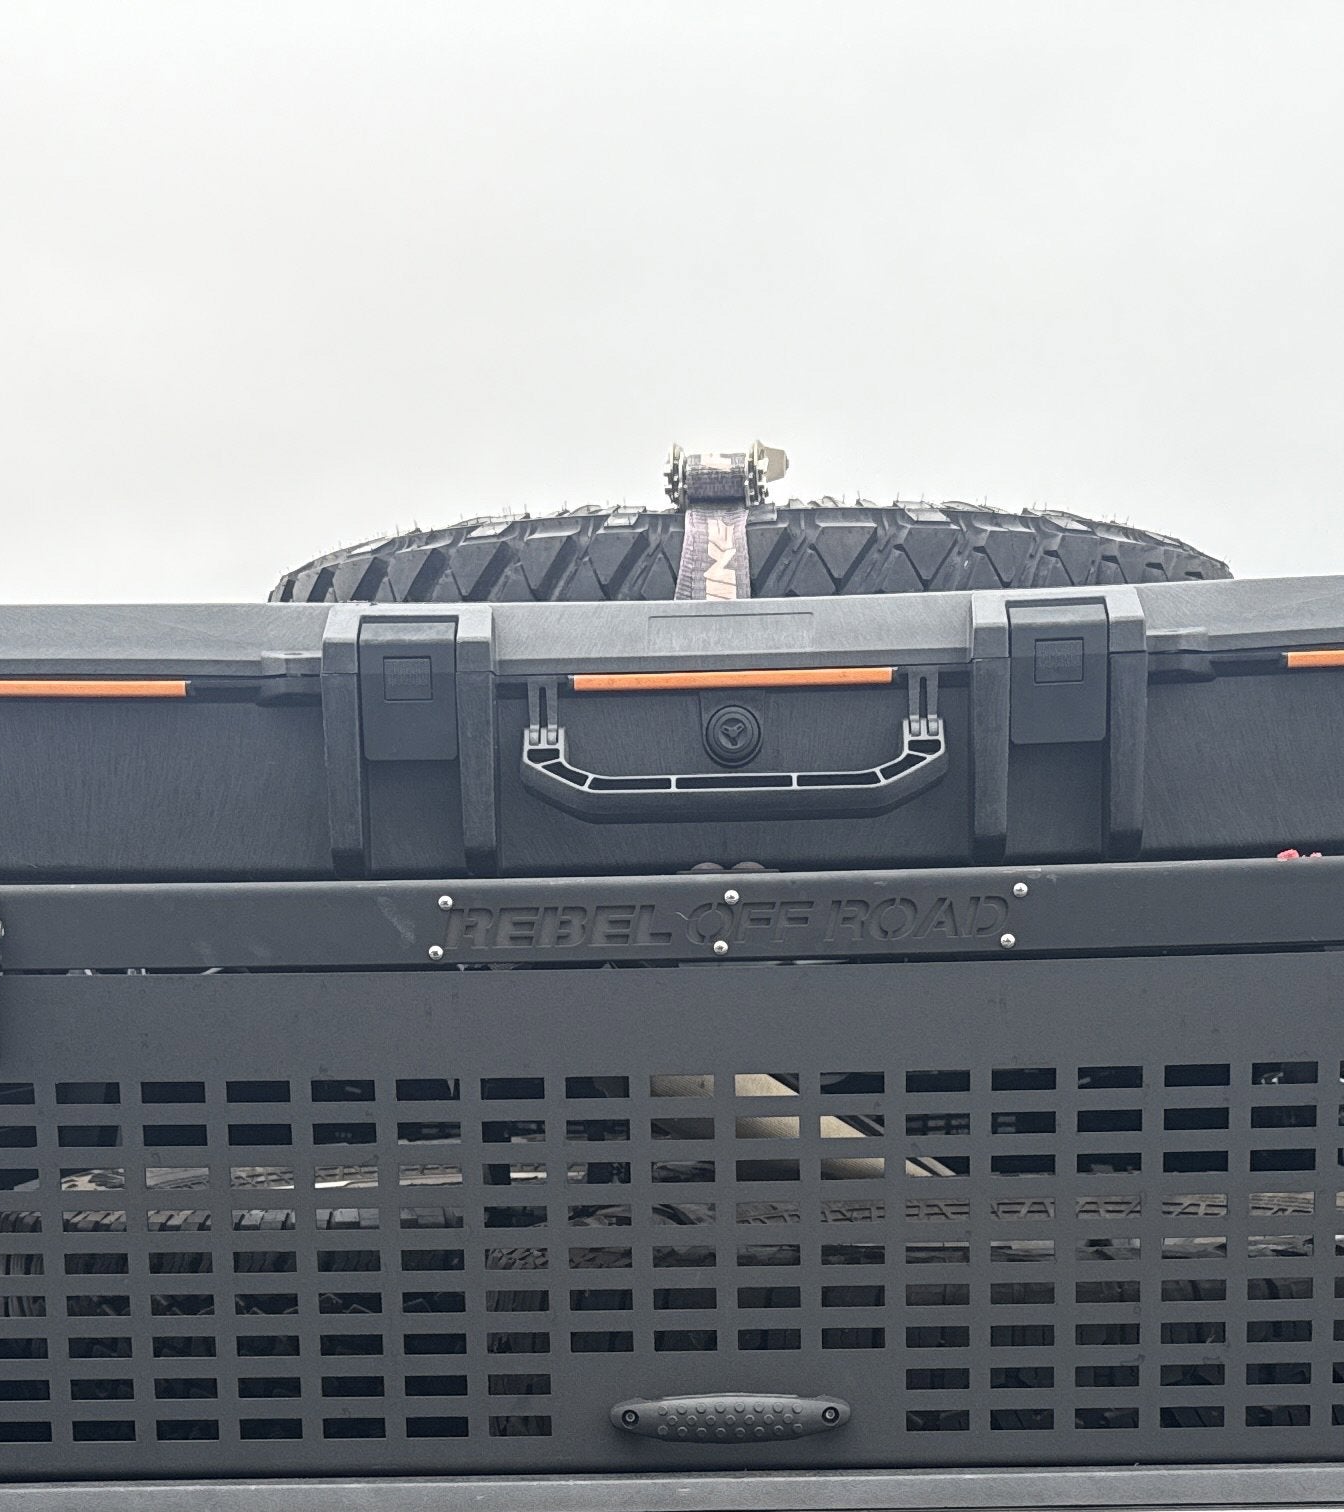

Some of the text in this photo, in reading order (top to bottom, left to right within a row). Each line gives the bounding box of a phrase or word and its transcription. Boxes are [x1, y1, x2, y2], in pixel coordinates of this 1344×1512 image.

[444, 894, 1011, 951] REBEL OFF ROAD
